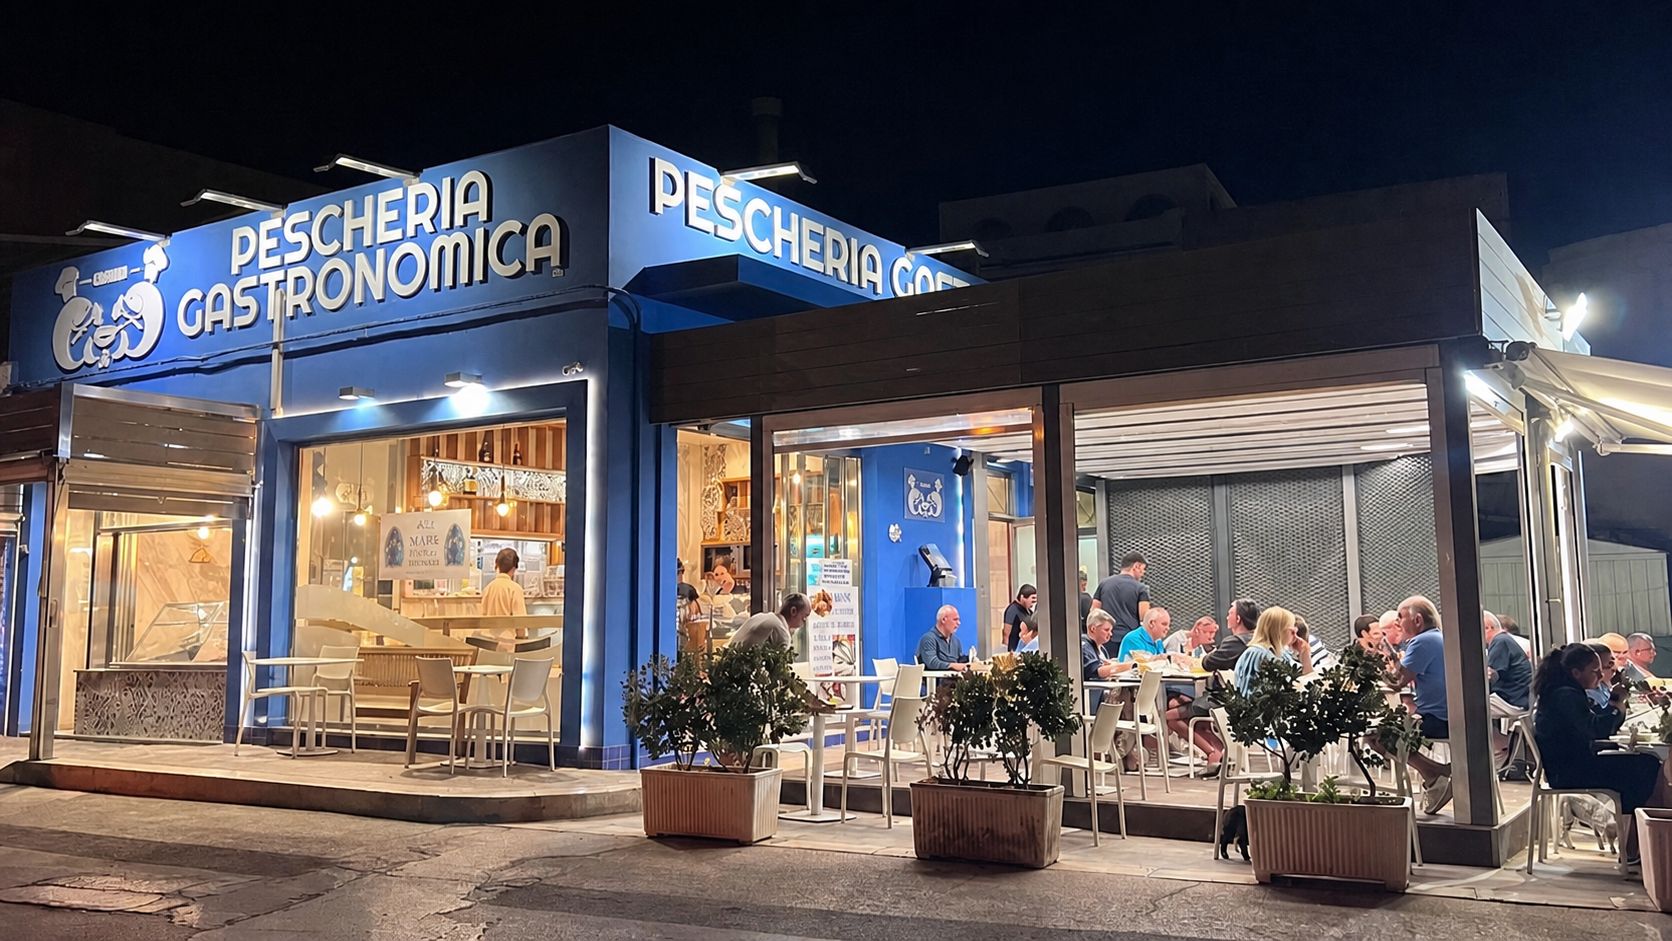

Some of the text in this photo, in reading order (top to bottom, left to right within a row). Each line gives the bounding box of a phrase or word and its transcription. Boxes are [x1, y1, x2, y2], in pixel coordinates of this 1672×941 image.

[177, 213, 562, 337] GASTRONOMICA
[231, 170, 490, 275] PESCHERIA
[651, 156, 883, 296] PESCHERIA
